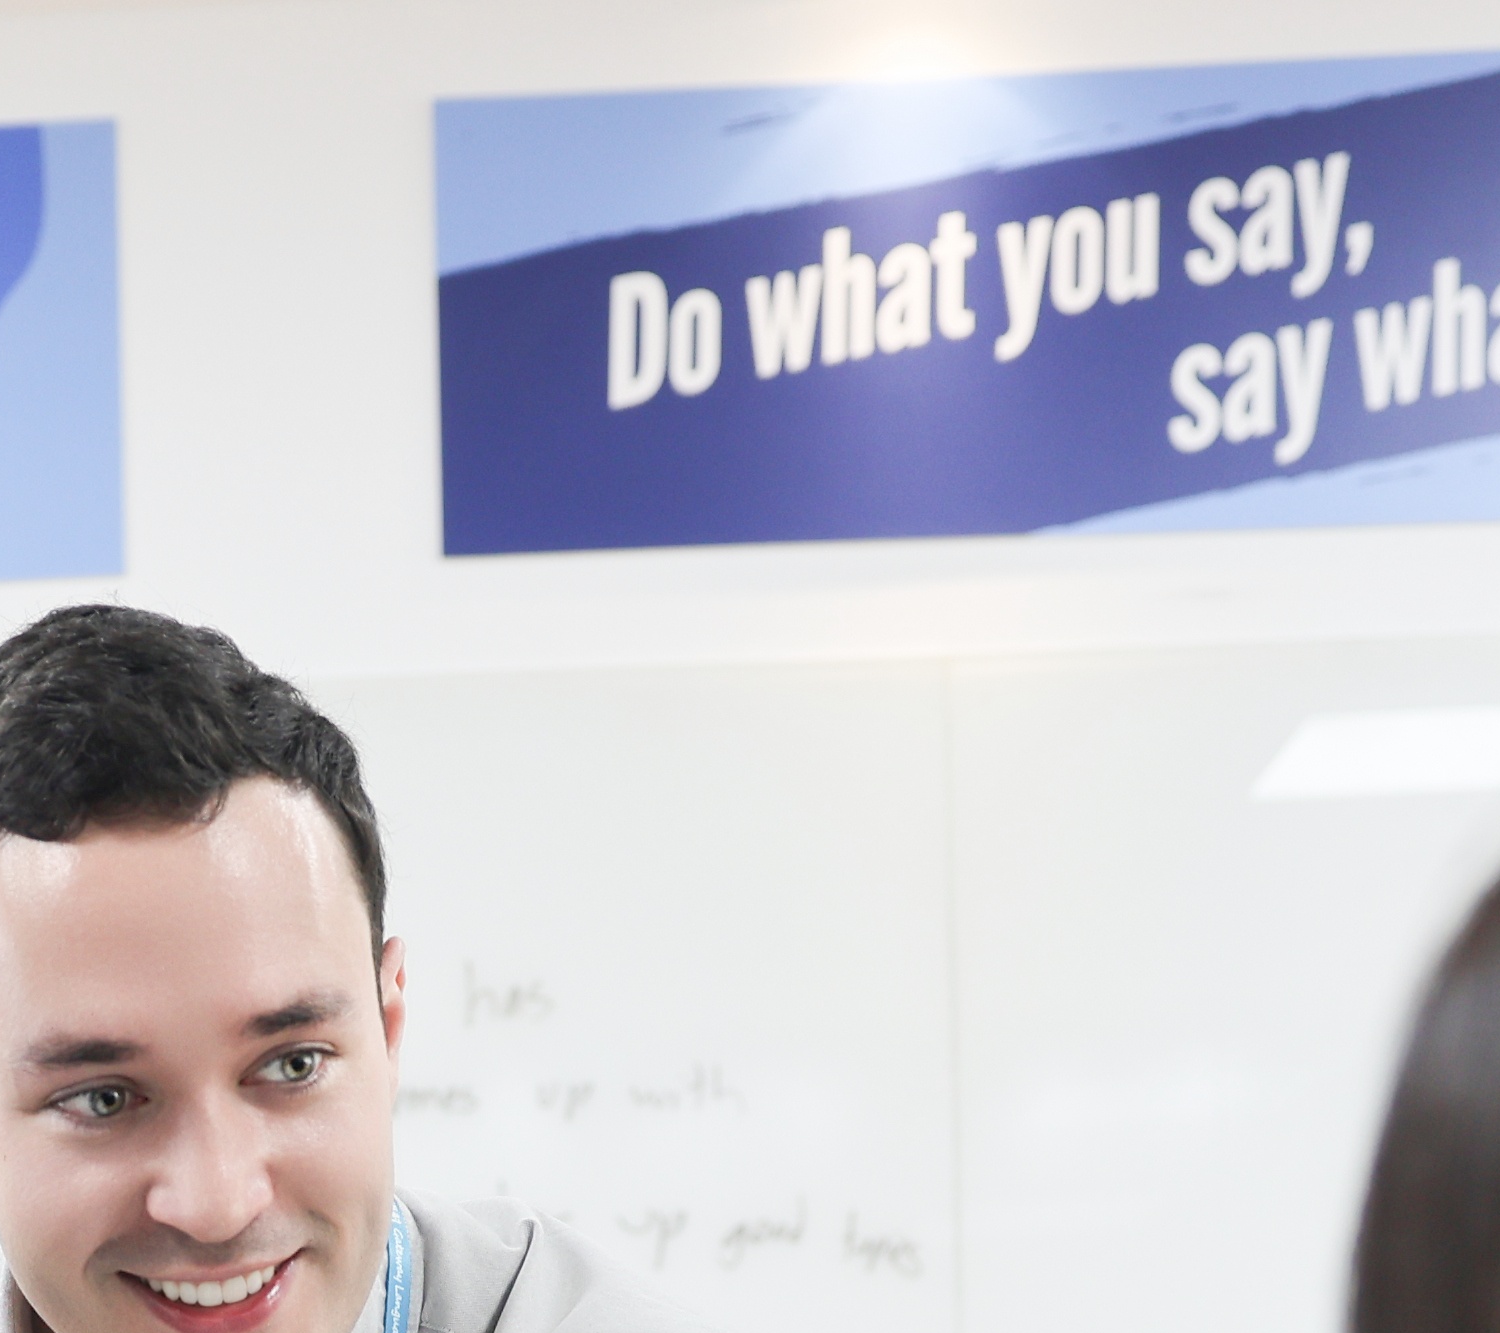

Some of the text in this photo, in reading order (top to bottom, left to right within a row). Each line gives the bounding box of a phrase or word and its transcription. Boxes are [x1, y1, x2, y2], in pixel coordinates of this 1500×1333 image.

[607, 151, 1374, 411] Do what you say,
[1166, 317, 1334, 466] say
[392, 1227, 405, 1284] Gateway
